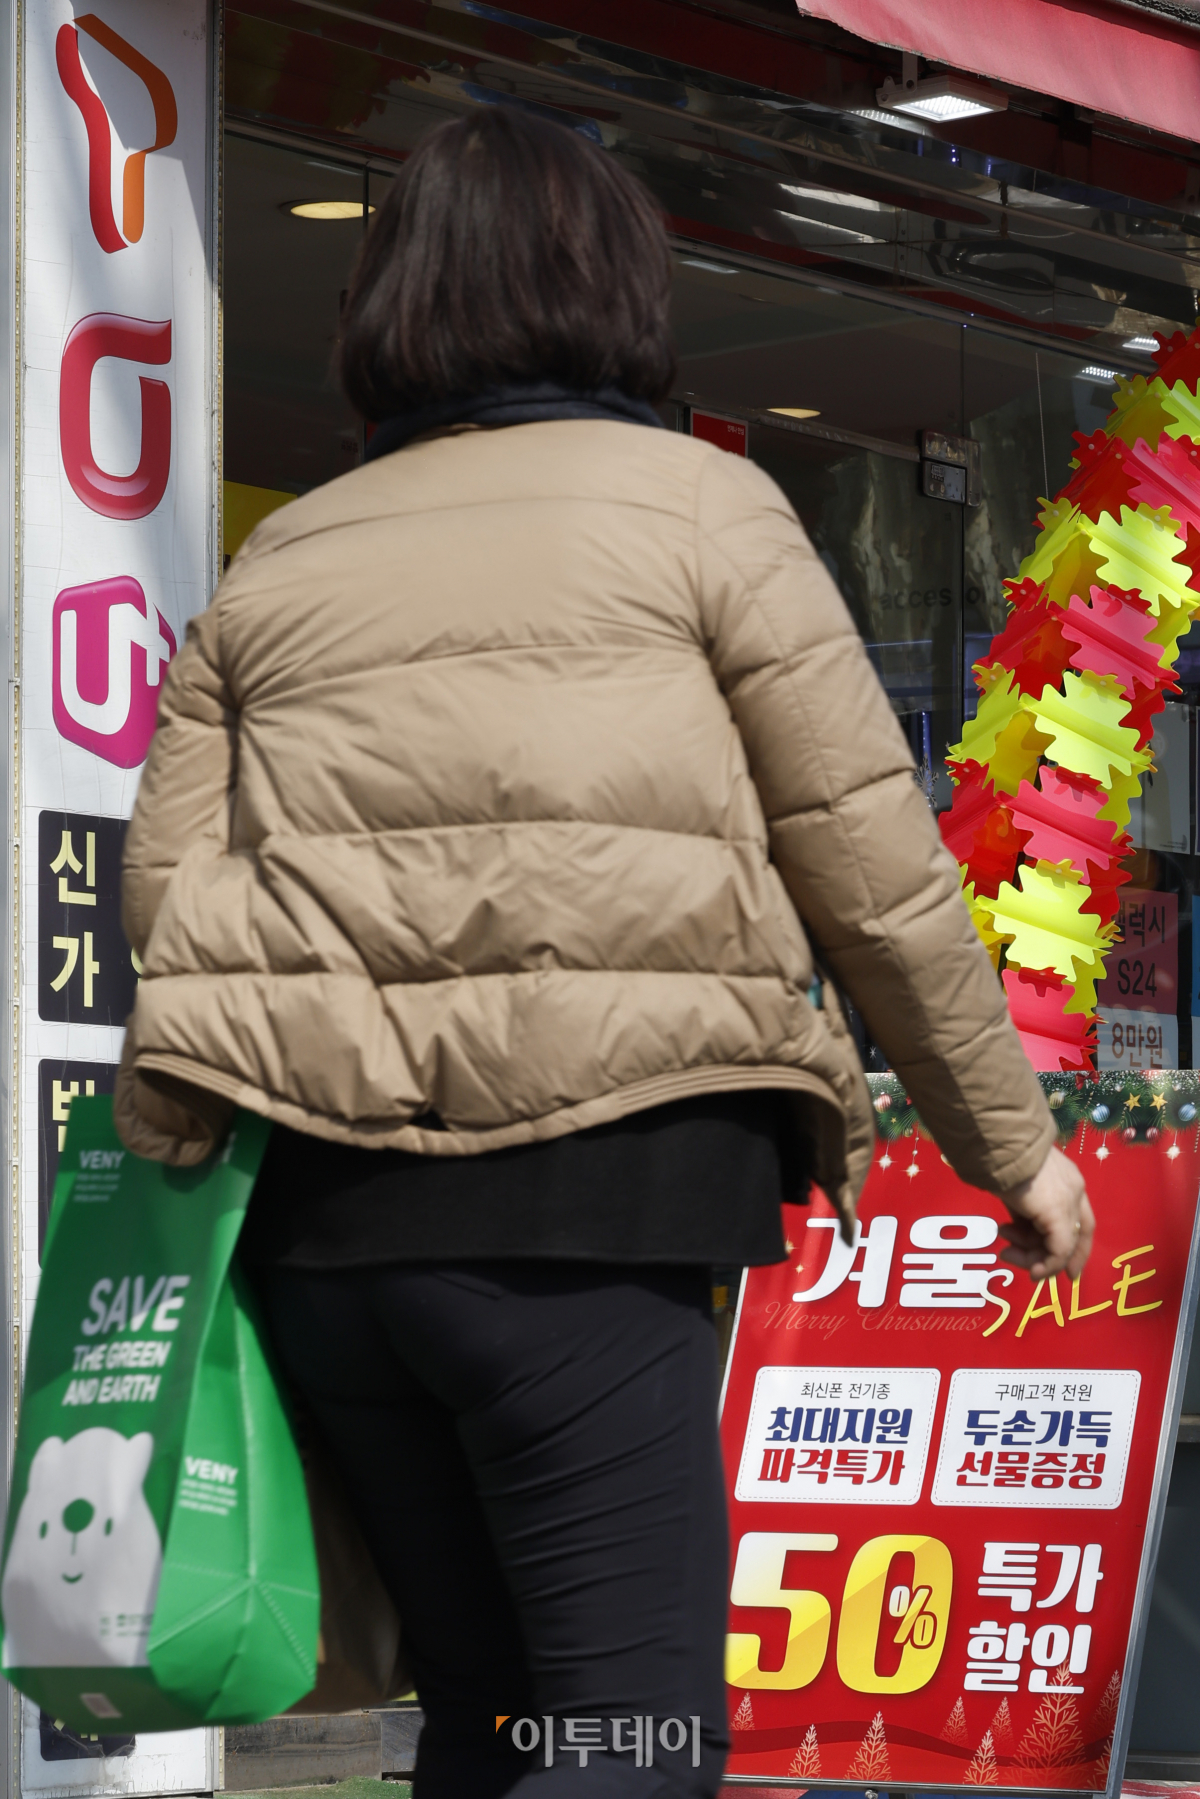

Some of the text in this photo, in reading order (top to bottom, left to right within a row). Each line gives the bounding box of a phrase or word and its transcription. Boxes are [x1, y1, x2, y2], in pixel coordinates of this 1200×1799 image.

[1117, 958, 1157, 997] S24
[1111, 1021, 1163, 1069] 8만원
[79, 1151, 126, 1169] VENY
[792, 1215, 999, 1308] 겨울
[81, 1275, 191, 1336] SAVE
[981, 1244, 1163, 1338] SALE
[762, 1300, 985, 1340] Merry Christmas
[73, 1340, 172, 1372] THE GREEN
[62, 1374, 162, 1406] AND EARTH
[801, 1382, 891, 1400] 최신폰 전기종
[995, 1383, 1093, 1402] 구매고객 전원
[765, 1406, 913, 1445] 최대지원
[963, 1409, 1113, 1448] 두손가득
[185, 1456, 238, 1485] VENY
[757, 1448, 906, 1486] 파격특가
[956, 1451, 1107, 1490] 선물증정
[977, 1541, 1104, 1613] 특가
[963, 1620, 1093, 1694] 할인
